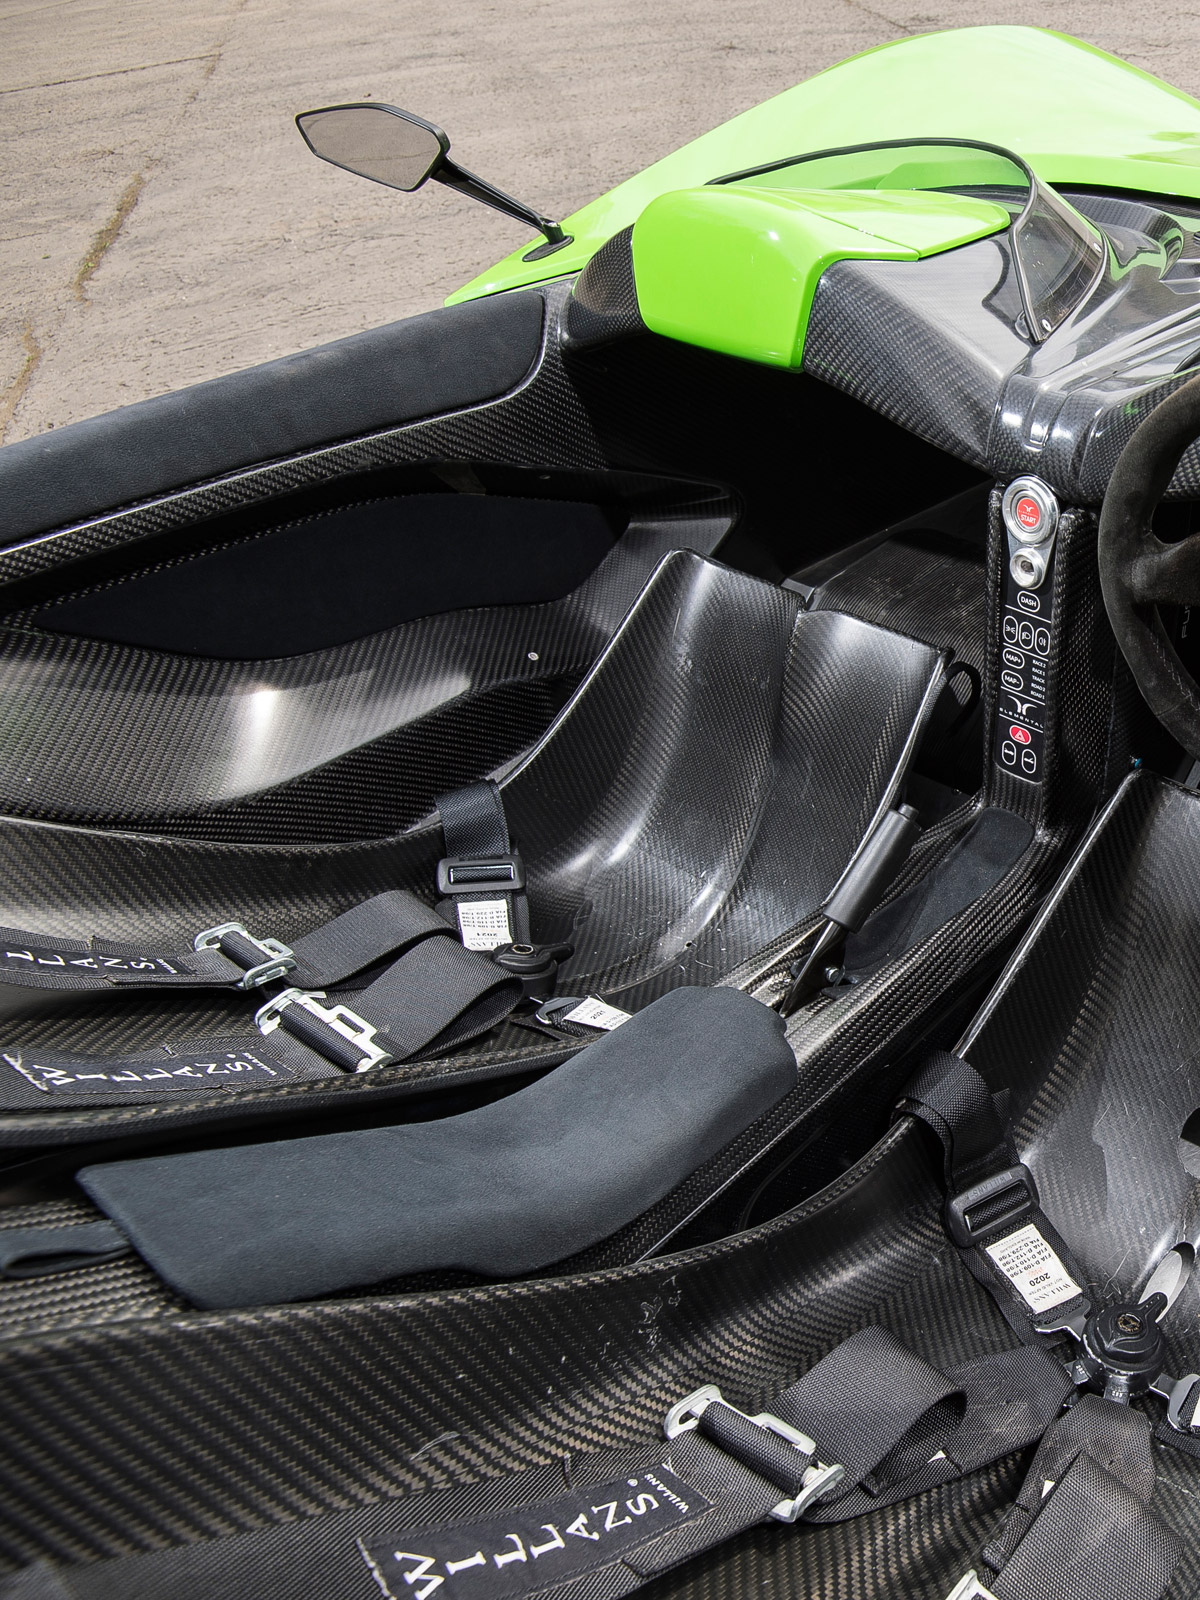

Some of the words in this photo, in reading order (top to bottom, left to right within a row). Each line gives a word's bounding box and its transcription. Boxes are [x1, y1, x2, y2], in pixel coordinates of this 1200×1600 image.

[1021, 514, 1036, 524] START
[1020, 596, 1037, 607] DASH
[1005, 653, 1021, 663] MAP+
[1004, 674, 1020, 684] MAP-
[1032, 674, 1046, 683] TRACK
[999, 708, 1044, 728] ELEMENTAL
[5, 950, 154, 970] LLANS
[32, 1063, 252, 1086] WILLANS
[1029, 1237, 1039, 1245] FIA
[1032, 1241, 1043, 1249] FIA
[1036, 1246, 1047, 1255] FIA
[1039, 1252, 1051, 1262] FIA
[1028, 1271, 1050, 1287] 2020
[644, 1473, 690, 1514] WILLANS
[394, 1493, 660, 1600] WILLANS
